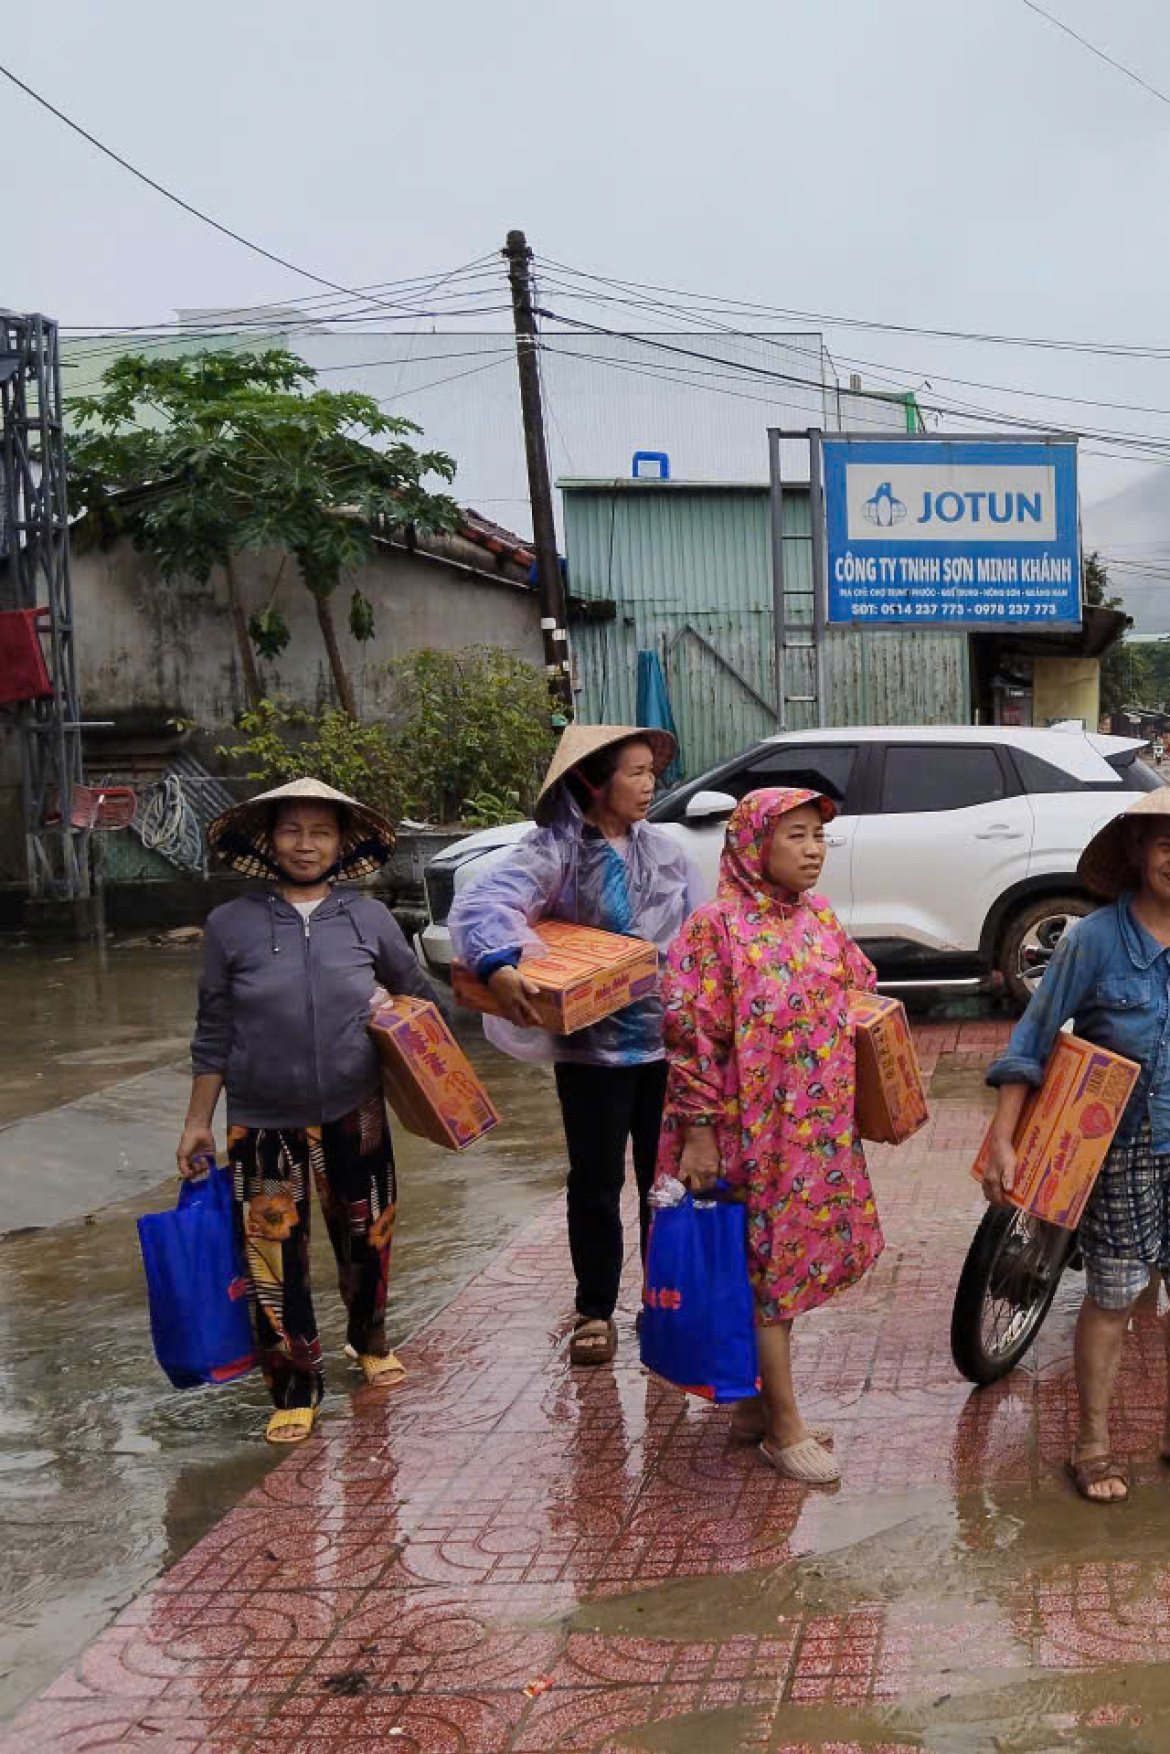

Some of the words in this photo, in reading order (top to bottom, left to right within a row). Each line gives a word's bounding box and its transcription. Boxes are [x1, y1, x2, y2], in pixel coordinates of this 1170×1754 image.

[917, 491, 1042, 523] JOTUN
[835, 550, 877, 582] CÔNG
[879, 557, 897, 582] TY
[899, 557, 940, 582] TNHH
[978, 557, 1018, 582] MINH
[1021, 551, 1072, 582] KHÁNH
[915, 603, 937, 615] 237
[941, 603, 964, 615] 773
[1008, 603, 1030, 615] 237
[1034, 603, 1057, 615] 773
